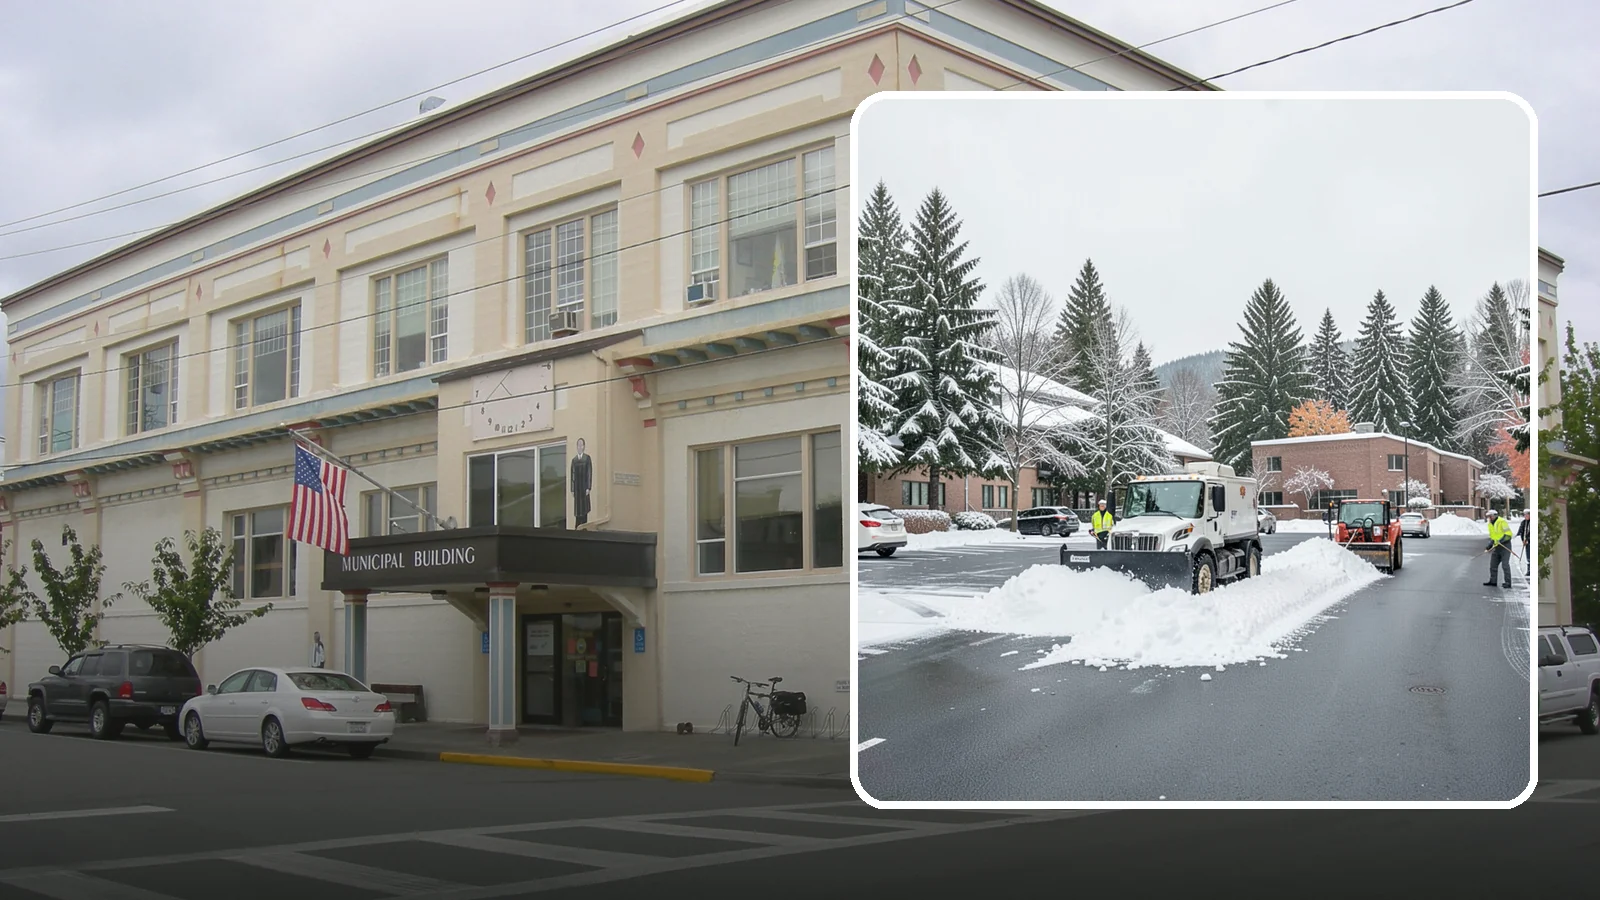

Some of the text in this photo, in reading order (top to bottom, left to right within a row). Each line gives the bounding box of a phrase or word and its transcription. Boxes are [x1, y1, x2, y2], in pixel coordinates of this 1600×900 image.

[481, 406, 485, 415] 8
[488, 417, 492, 426] 9
[507, 425, 513, 433] 12
[521, 420, 525, 428] 2
[529, 413, 533, 422] 3
[342, 546, 475, 572] MUNICIPAL BUILDING
